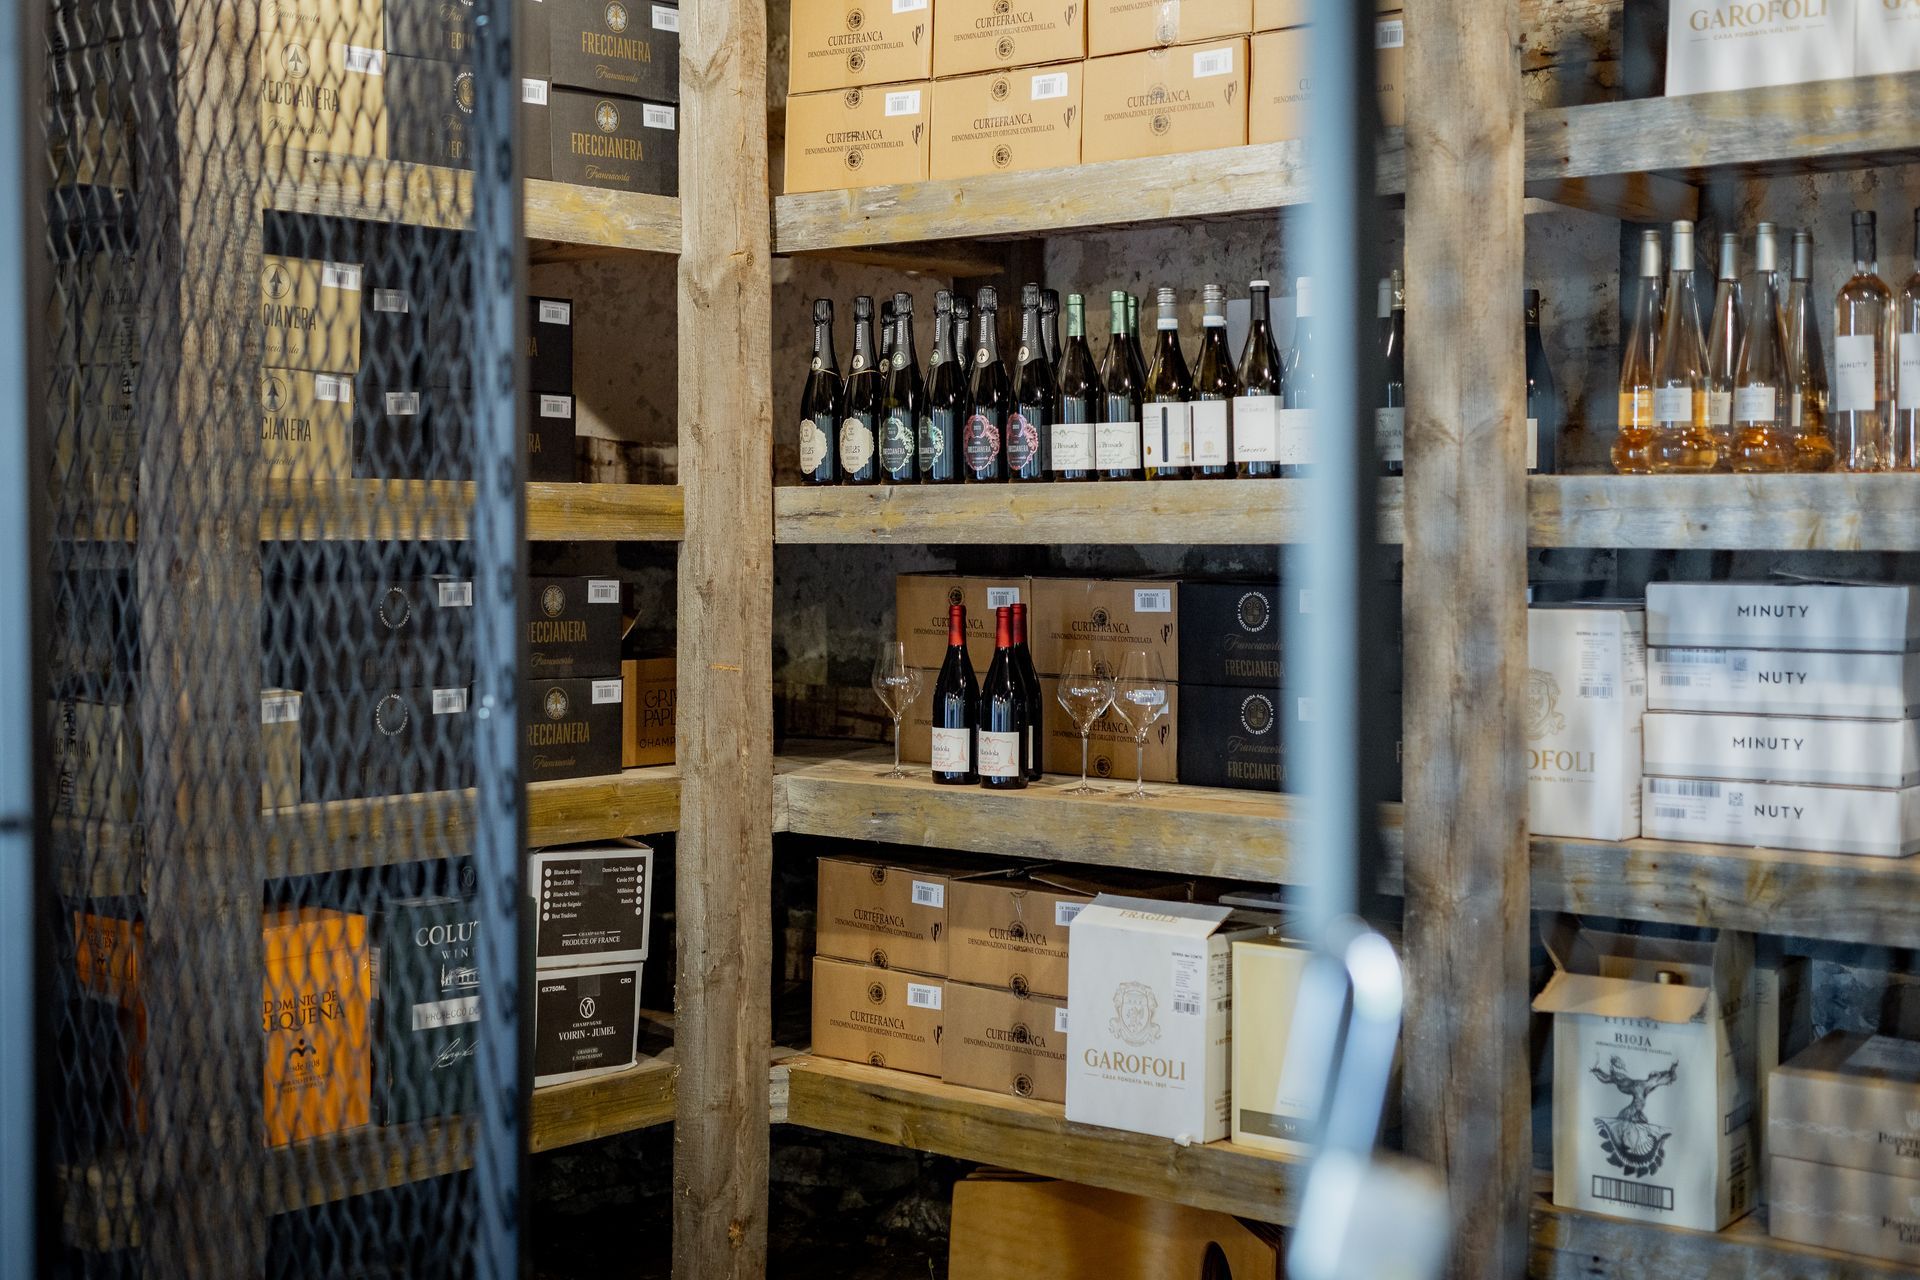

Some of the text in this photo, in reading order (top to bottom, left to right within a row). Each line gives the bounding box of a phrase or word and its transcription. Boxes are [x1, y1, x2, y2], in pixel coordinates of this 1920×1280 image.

[975, 12, 1034, 30] CURTEFRANCA
[582, 31, 651, 62] FRECCIANERA
[828, 29, 884, 47] CURTEFRANCA
[1127, 89, 1190, 109] CURTEFRANCA
[973, 112, 1032, 130] CURTEFRANCA
[825, 129, 883, 144] CURTEFRANCA
[571, 132, 644, 161] FRECCIANERA
[263, 302, 317, 331] CIANERA
[261, 416, 312, 442] CIANERA
[1237, 591, 1270, 609] AZIENDA AGRICOLA
[1736, 604, 1810, 619] MINUTY
[1071, 620, 1130, 633] CURTEFRANCA
[1237, 613, 1251, 632] FRATELLI
[1225, 659, 1286, 678] FRECCIANERA
[1758, 671, 1807, 685] NUTY
[1241, 694, 1274, 712] AZIENDA AGRICOLA
[1240, 715, 1274, 735] FRATELLI BERLUCCHI
[1732, 736, 1804, 752] MINUTY
[1227, 760, 1289, 781] FRECCIANERA
[1754, 804, 1804, 820] NUTY
[853, 908, 905, 928] CURTEFRANCA
[1119, 909, 1180, 924] FRAGILE
[562, 935, 621, 947] PRODUCE OF FRANCE
[988, 927, 1047, 946] CURTEFRANCA
[541, 985, 567, 993] 6X750ML
[264, 990, 337, 1014] DOMINIC DE
[572, 1020, 603, 1028] CHAMPAGNE
[850, 1010, 905, 1030] CURTEFRANCA
[558, 1029, 586, 1041] VOIRIN
[591, 1026, 617, 1038] JUMEL
[829, 1019, 867, 1033] DENOMINAZIONE
[893, 1029, 925, 1043] CONTROLLATA
[985, 1027, 1046, 1048] CURTEFRANCA
[1615, 1032, 1652, 1048] RIOJA
[1033, 1048, 1067, 1060] CONTROLLAT
[1084, 1048, 1186, 1081] GAROFOLI
[1102, 1073, 1116, 1081] CASA
[1117, 1075, 1142, 1085] FONDATA
[1143, 1079, 1154, 1087] NEL
